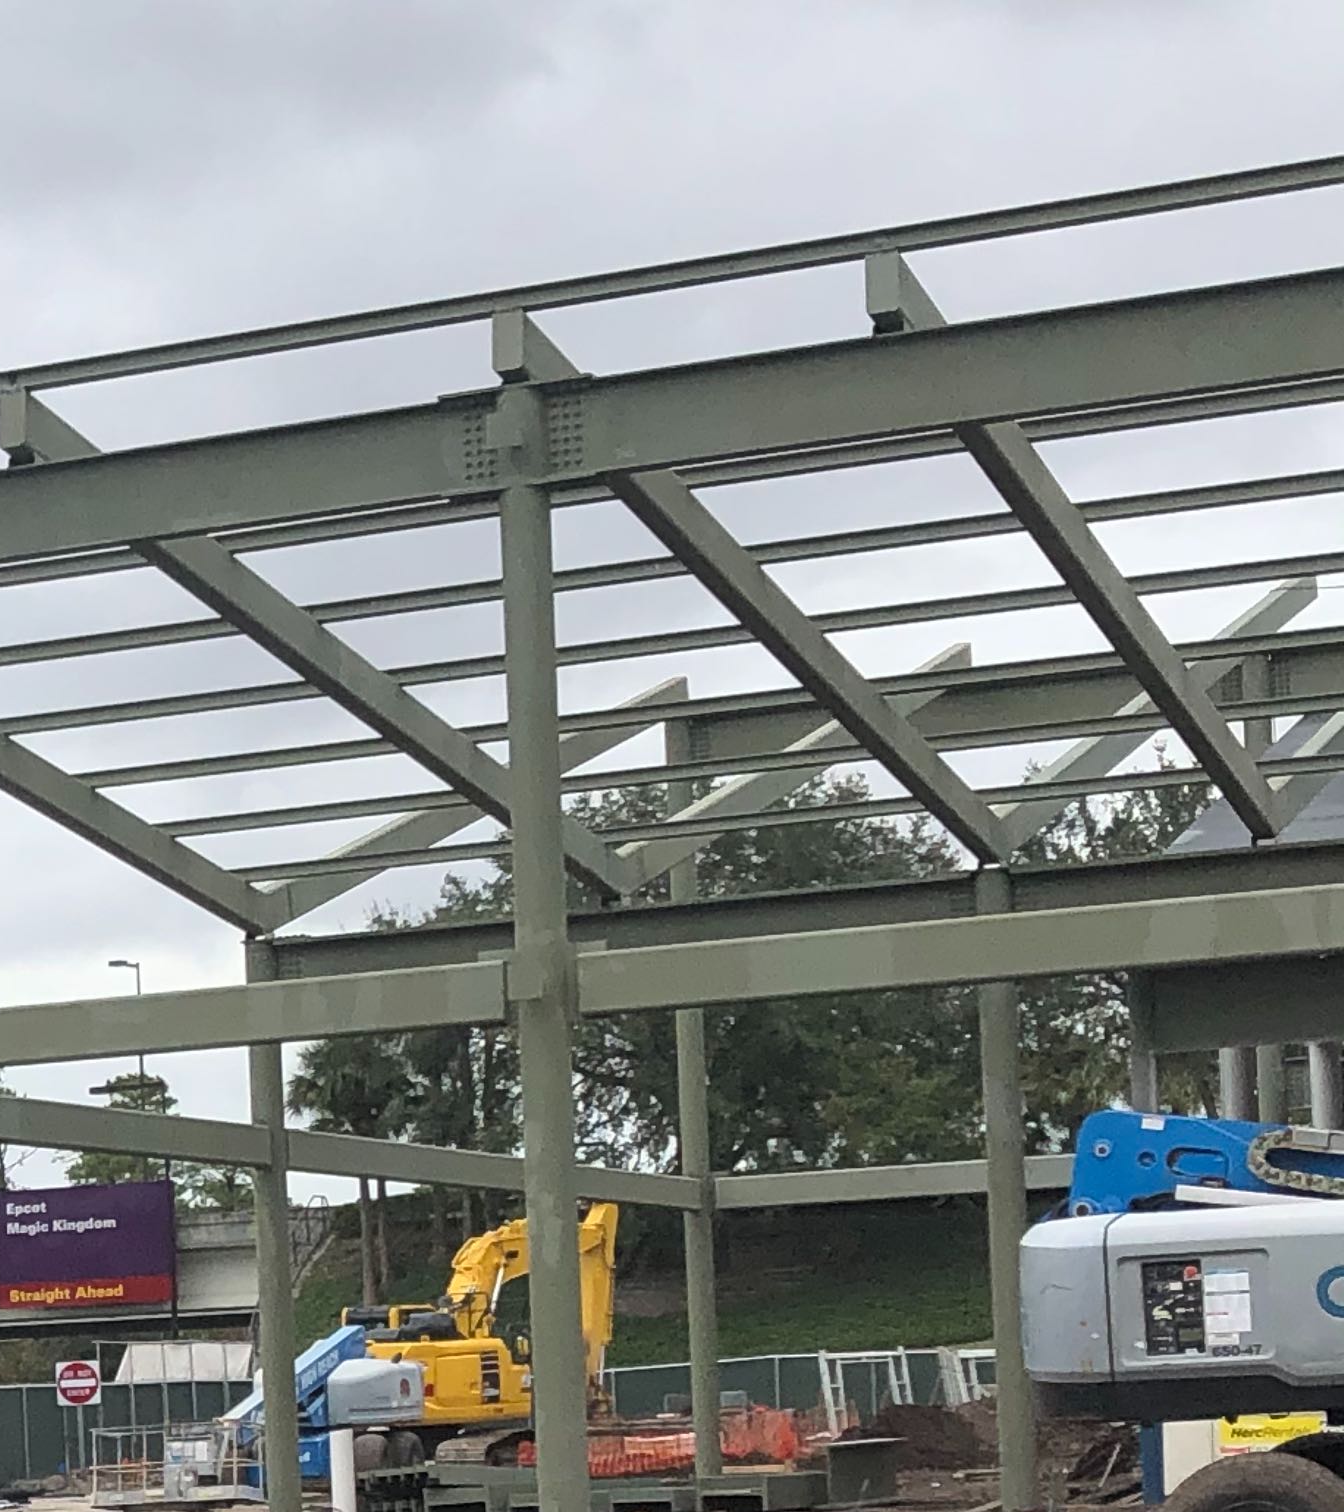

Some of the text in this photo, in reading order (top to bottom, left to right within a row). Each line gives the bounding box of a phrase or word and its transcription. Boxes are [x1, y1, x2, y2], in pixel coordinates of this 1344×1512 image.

[6, 1202, 47, 1217] Epcot
[6, 1217, 117, 1236] Magic Kingdom
[9, 1284, 124, 1304] Straight Ahead
